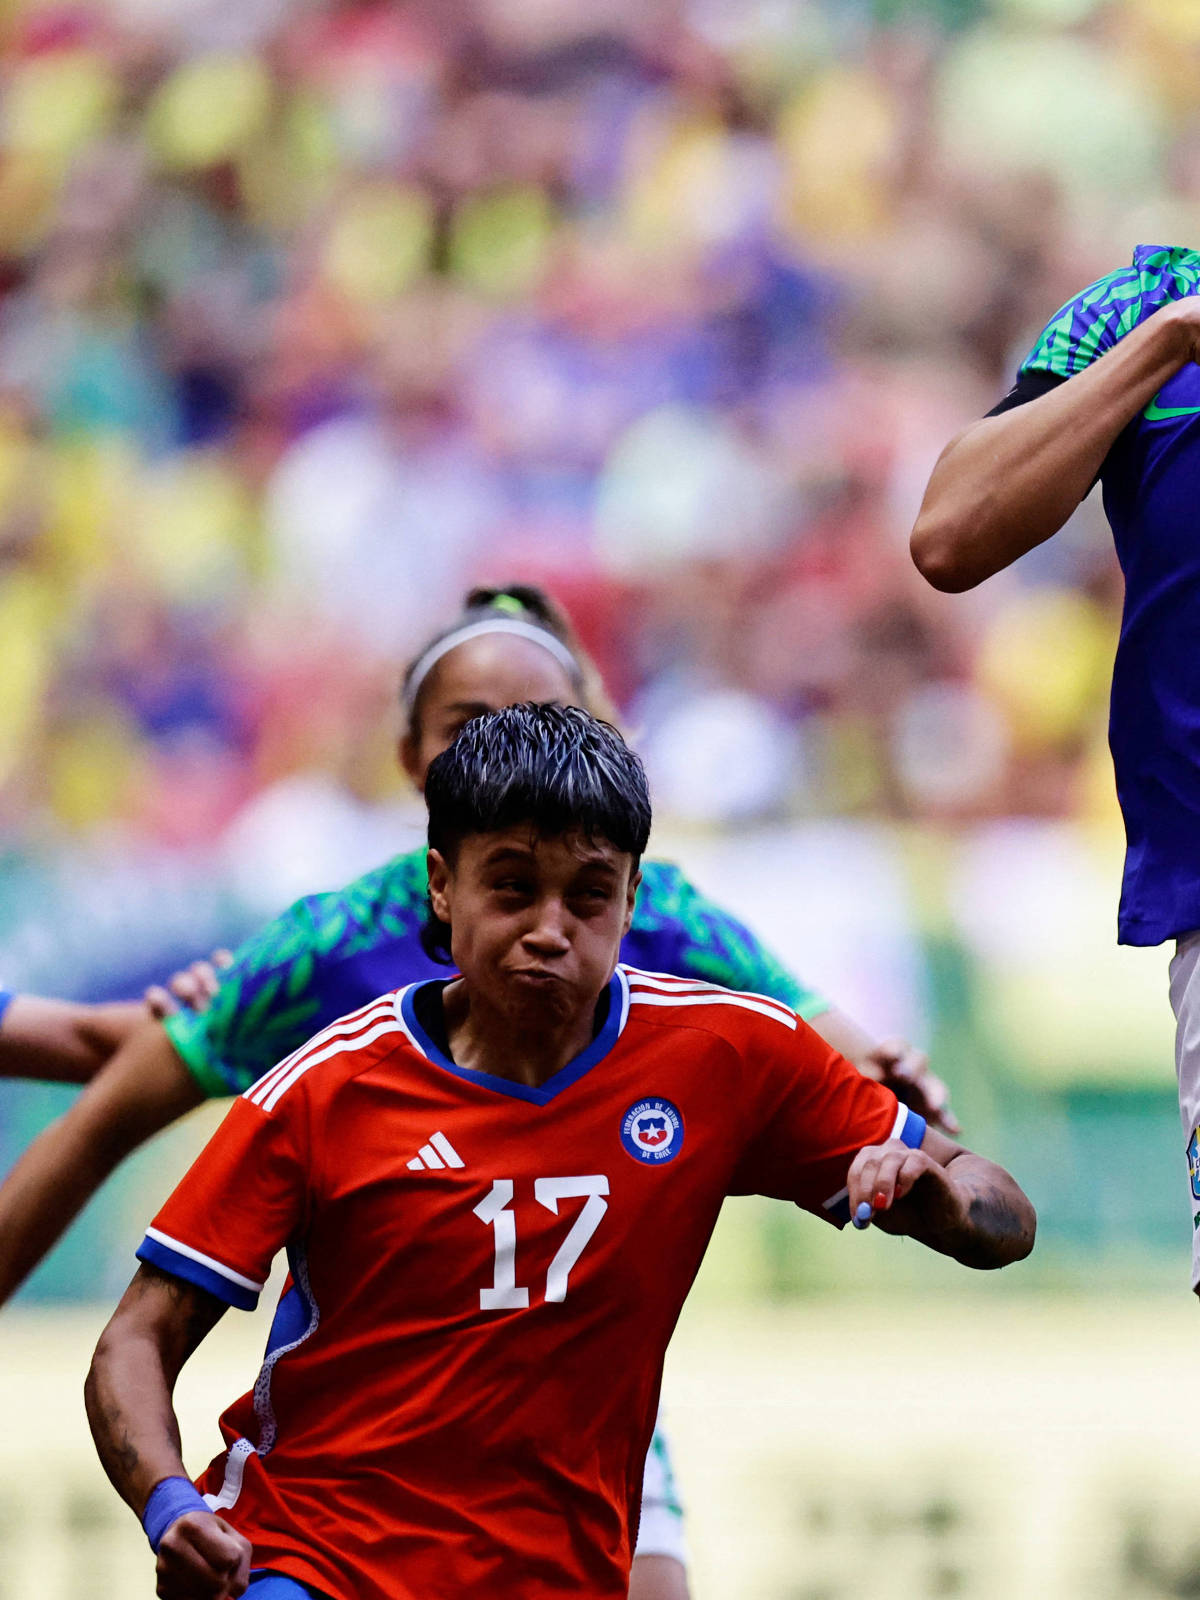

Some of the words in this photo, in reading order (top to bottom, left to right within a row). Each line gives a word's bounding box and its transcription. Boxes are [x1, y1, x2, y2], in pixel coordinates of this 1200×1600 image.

[655, 1102, 663, 1111] DE
[642, 1151, 650, 1159] DE
[472, 1174, 610, 1311] 17
